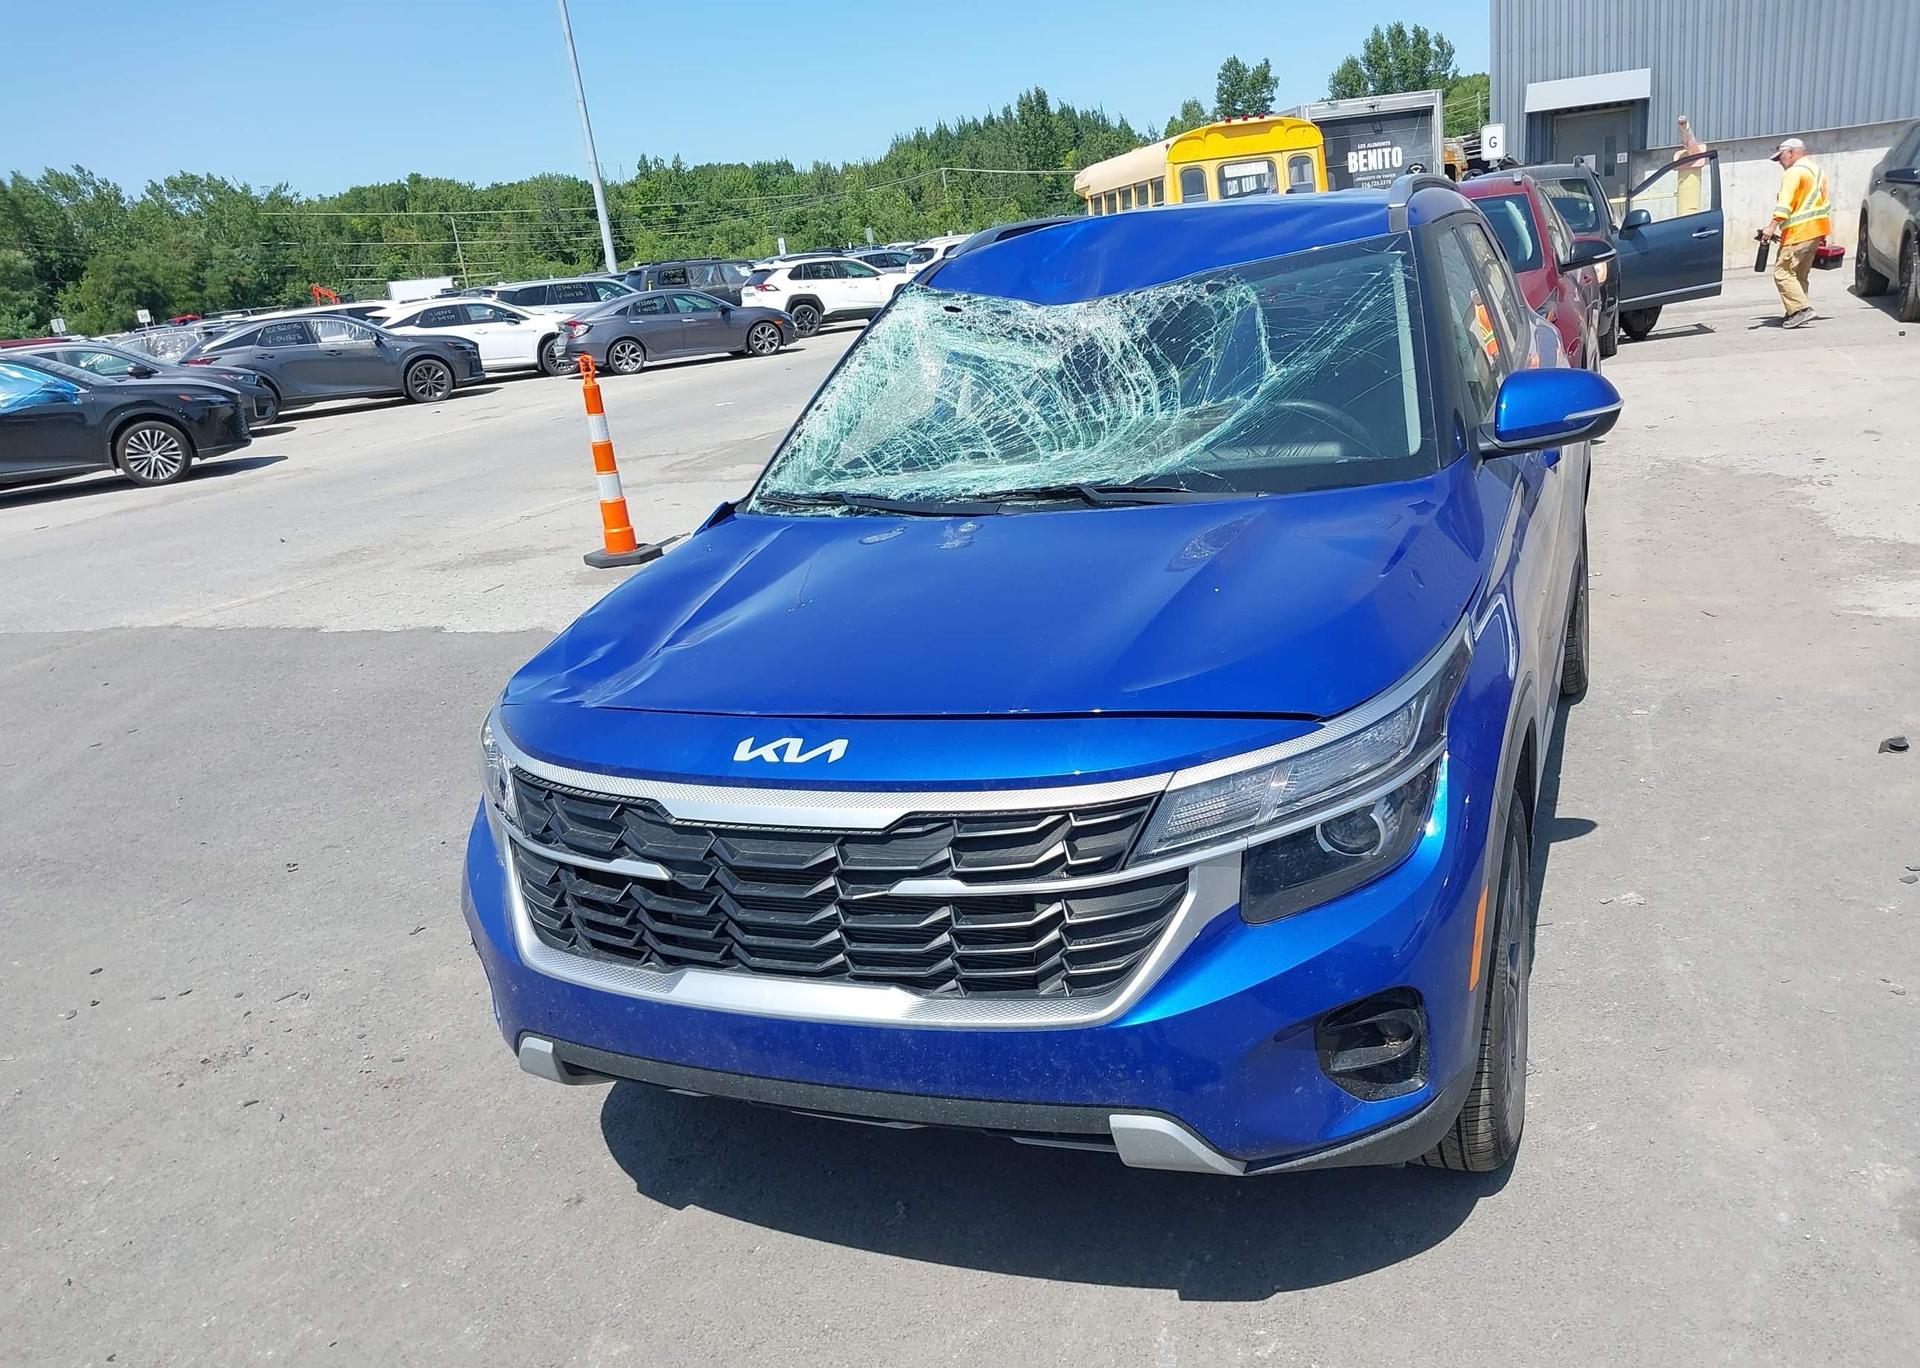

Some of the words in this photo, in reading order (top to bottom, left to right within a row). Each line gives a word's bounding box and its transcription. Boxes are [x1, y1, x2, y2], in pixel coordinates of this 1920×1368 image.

[1489, 136, 1498, 149] G
[1347, 146, 1403, 174] BENITO
[733, 736, 849, 763] KIA
